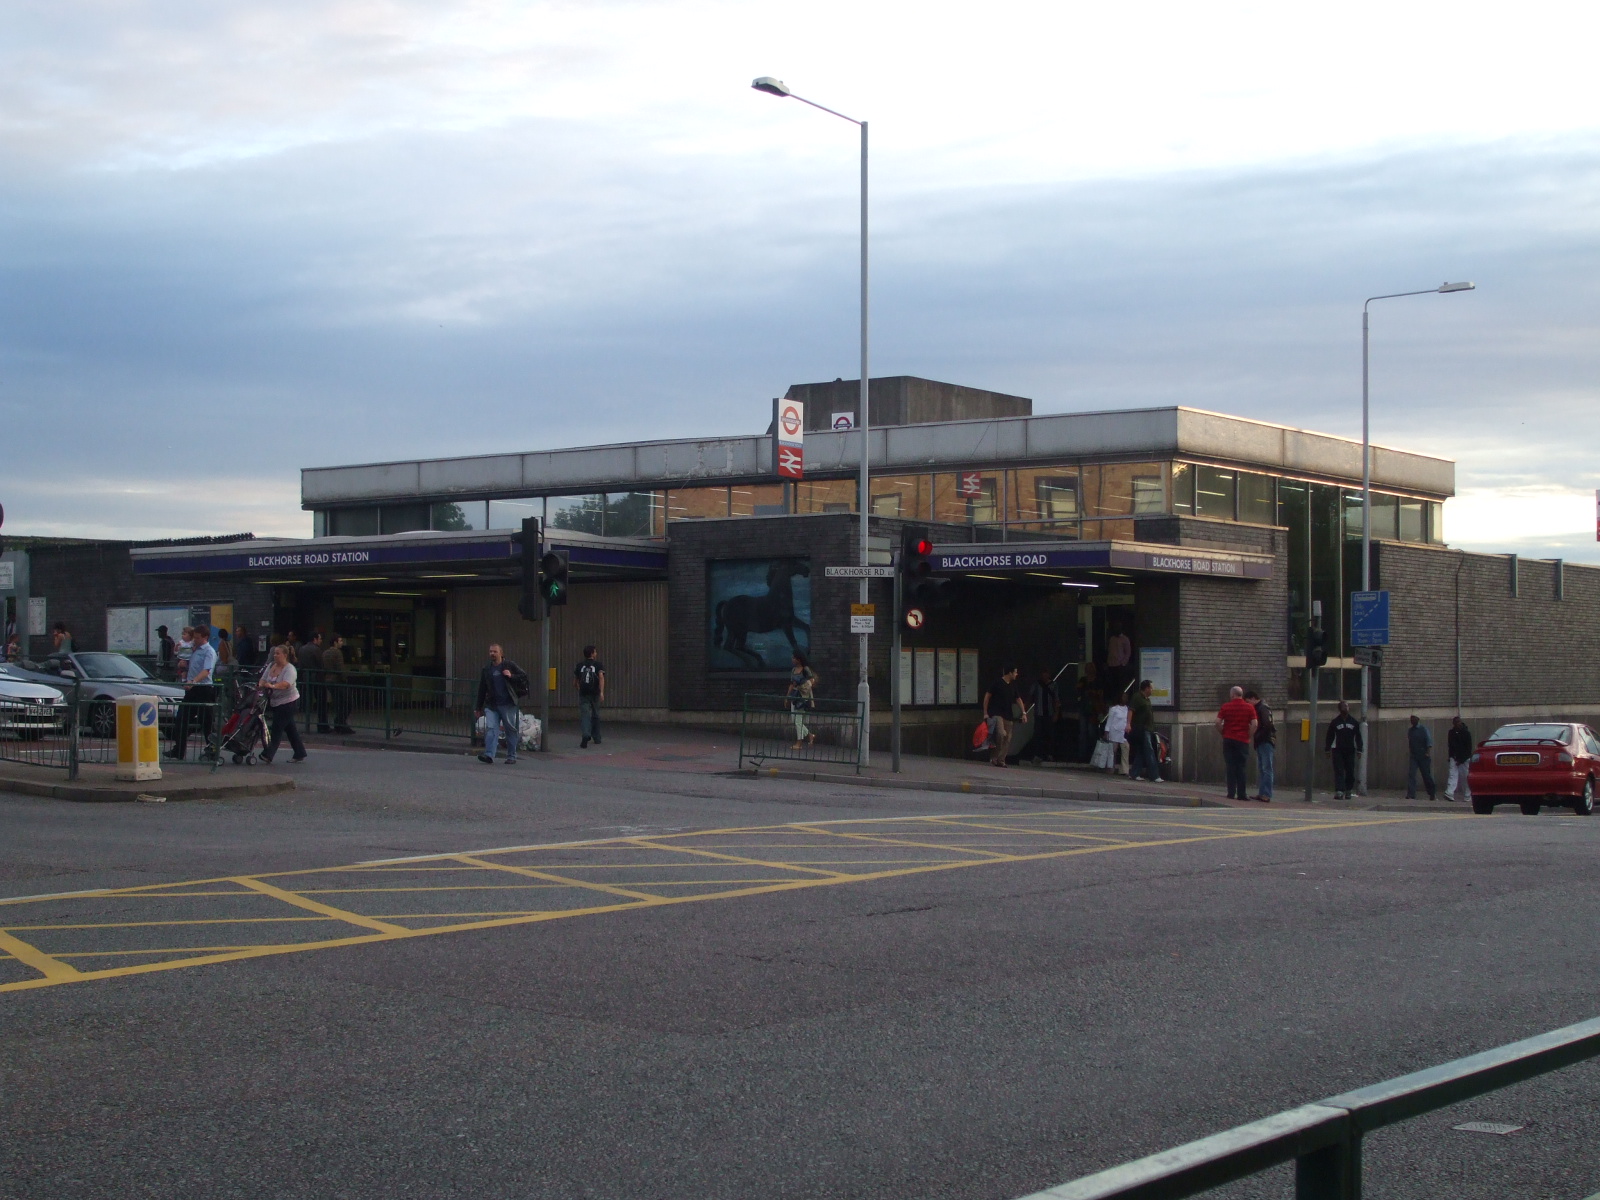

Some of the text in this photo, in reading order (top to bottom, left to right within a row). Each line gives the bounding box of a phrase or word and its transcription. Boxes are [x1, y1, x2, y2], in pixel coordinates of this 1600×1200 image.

[248, 552, 369, 567] BLACKHORSE ROAD STATION
[942, 555, 1047, 568] BLACKHORSE ROAD
[1152, 557, 1236, 573] BLACKHORSE ROAD STATION
[826, 568, 872, 576] BLACKHORSE
